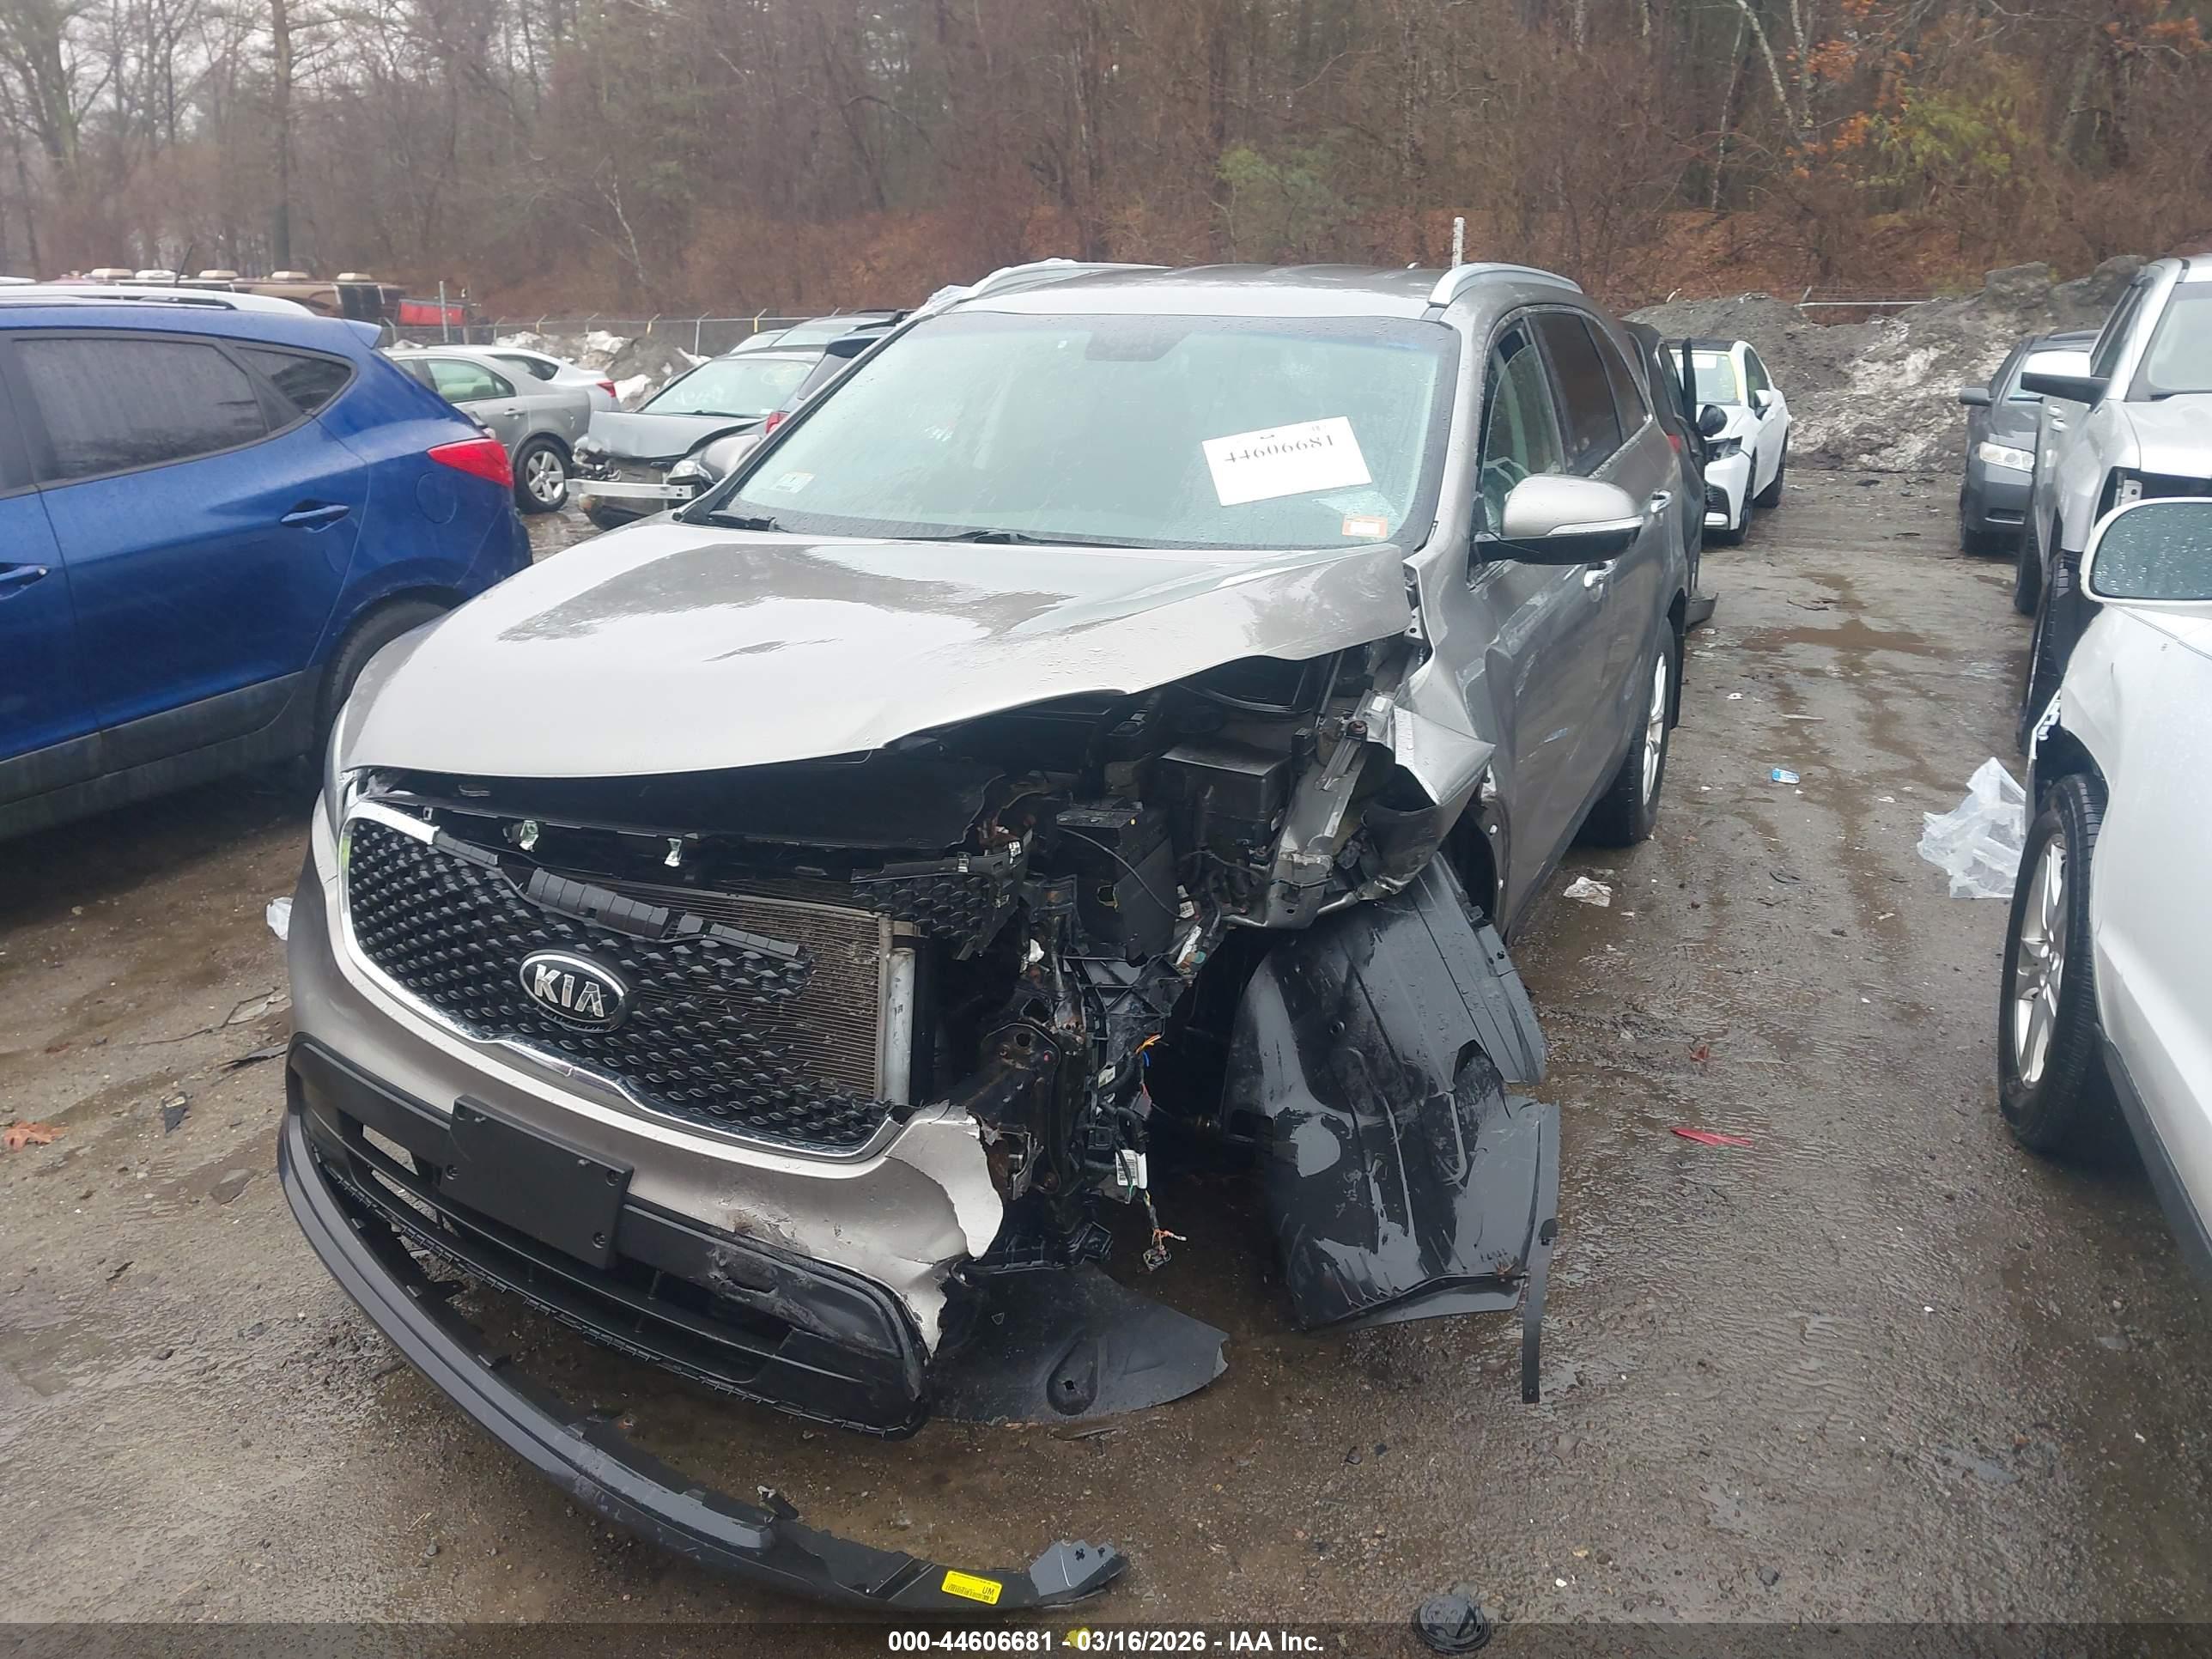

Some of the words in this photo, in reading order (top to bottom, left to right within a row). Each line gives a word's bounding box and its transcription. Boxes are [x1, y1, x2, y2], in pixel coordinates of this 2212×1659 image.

[1225, 434, 1334, 463] 44606681
[534, 963, 605, 1017] KIA
[981, 1586, 995, 1596] UM
